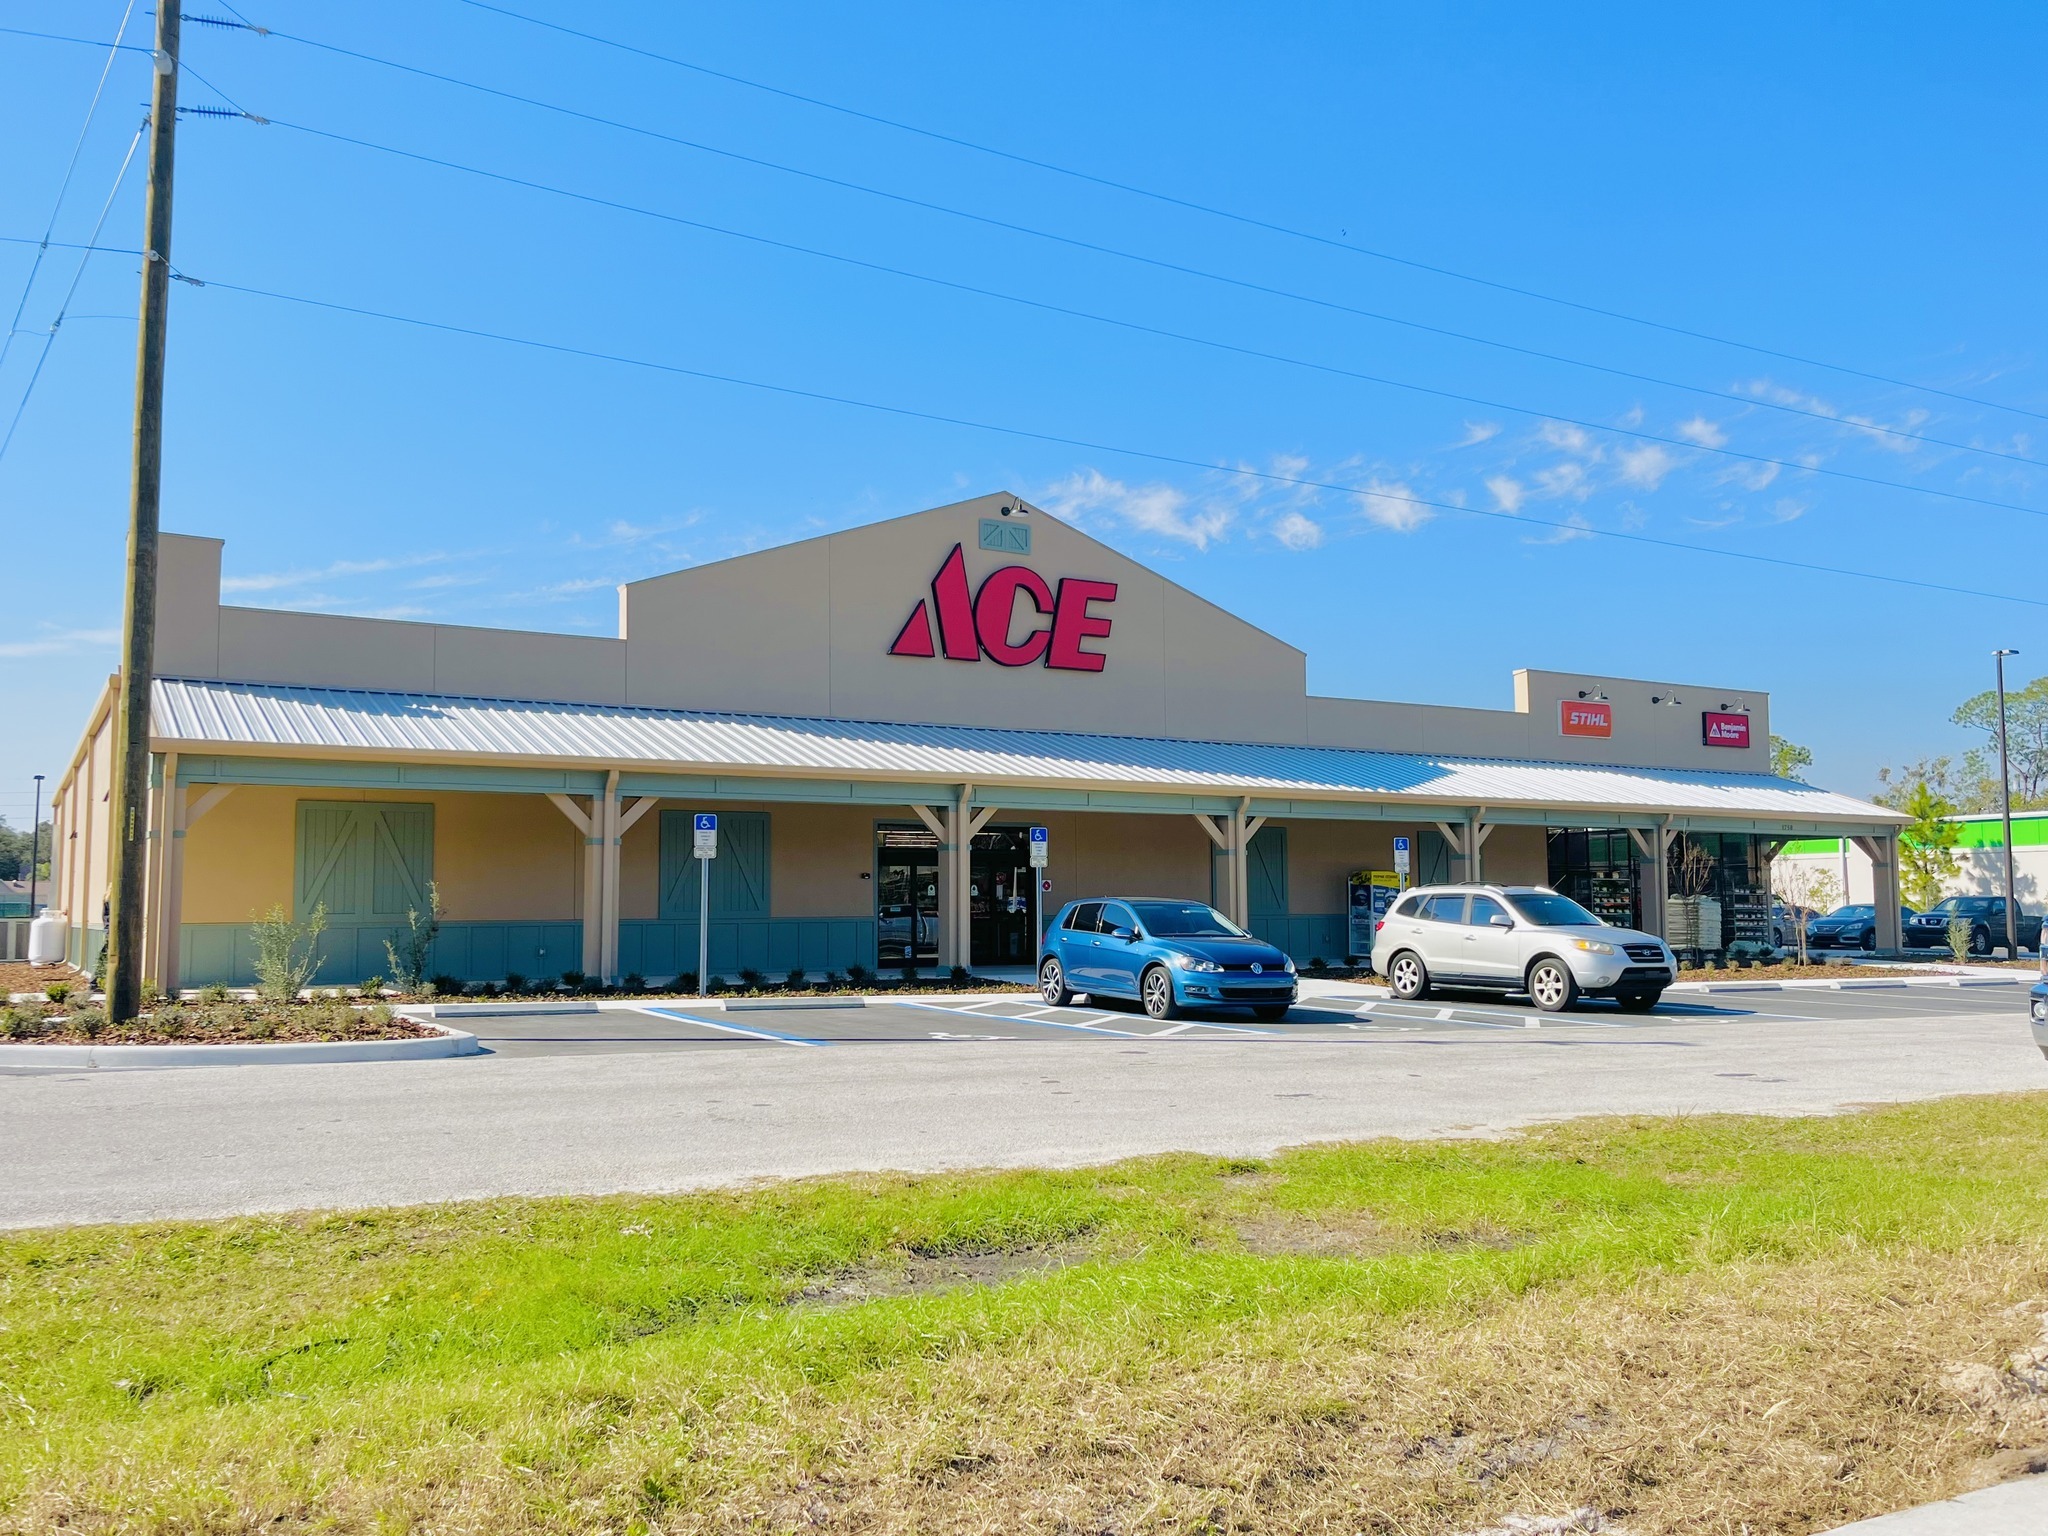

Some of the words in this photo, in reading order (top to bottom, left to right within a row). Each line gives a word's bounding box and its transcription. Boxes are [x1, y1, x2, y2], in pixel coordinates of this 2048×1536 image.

[887, 542, 1118, 672] ACE
[1570, 712, 1608, 727] STIHL
[1721, 722, 1746, 732] Benjamin
[1721, 730, 1739, 739] Moore
